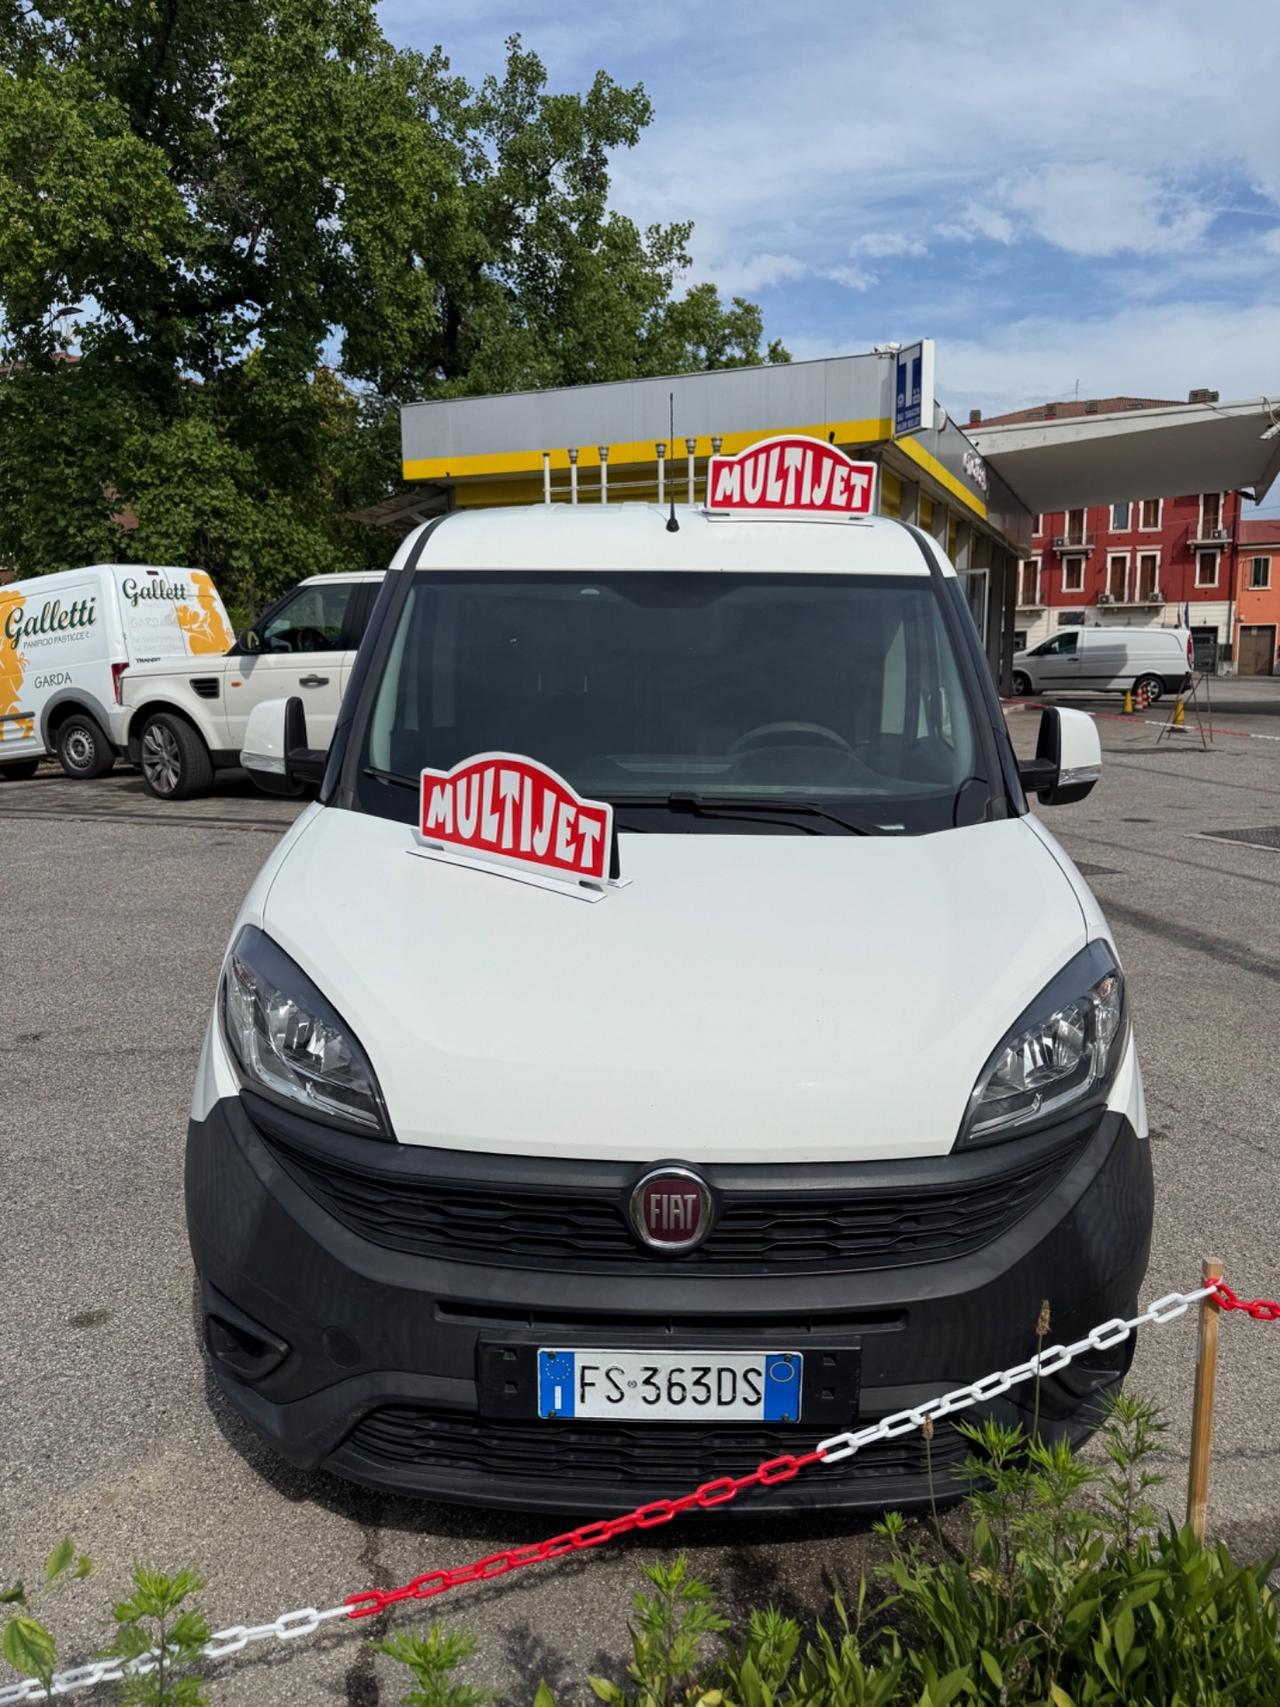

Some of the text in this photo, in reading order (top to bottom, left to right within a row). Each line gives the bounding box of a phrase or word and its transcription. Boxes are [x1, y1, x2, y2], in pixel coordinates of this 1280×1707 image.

[714, 446, 869, 508] MULTIJET
[5, 597, 96, 650] Galletti
[34, 671, 73, 689] GARDA
[426, 767, 602, 868] MULTIJET
[650, 1194, 697, 1230] FIAT
[579, 1366, 625, 1404] FS
[640, 1366, 763, 1407] 363DS
